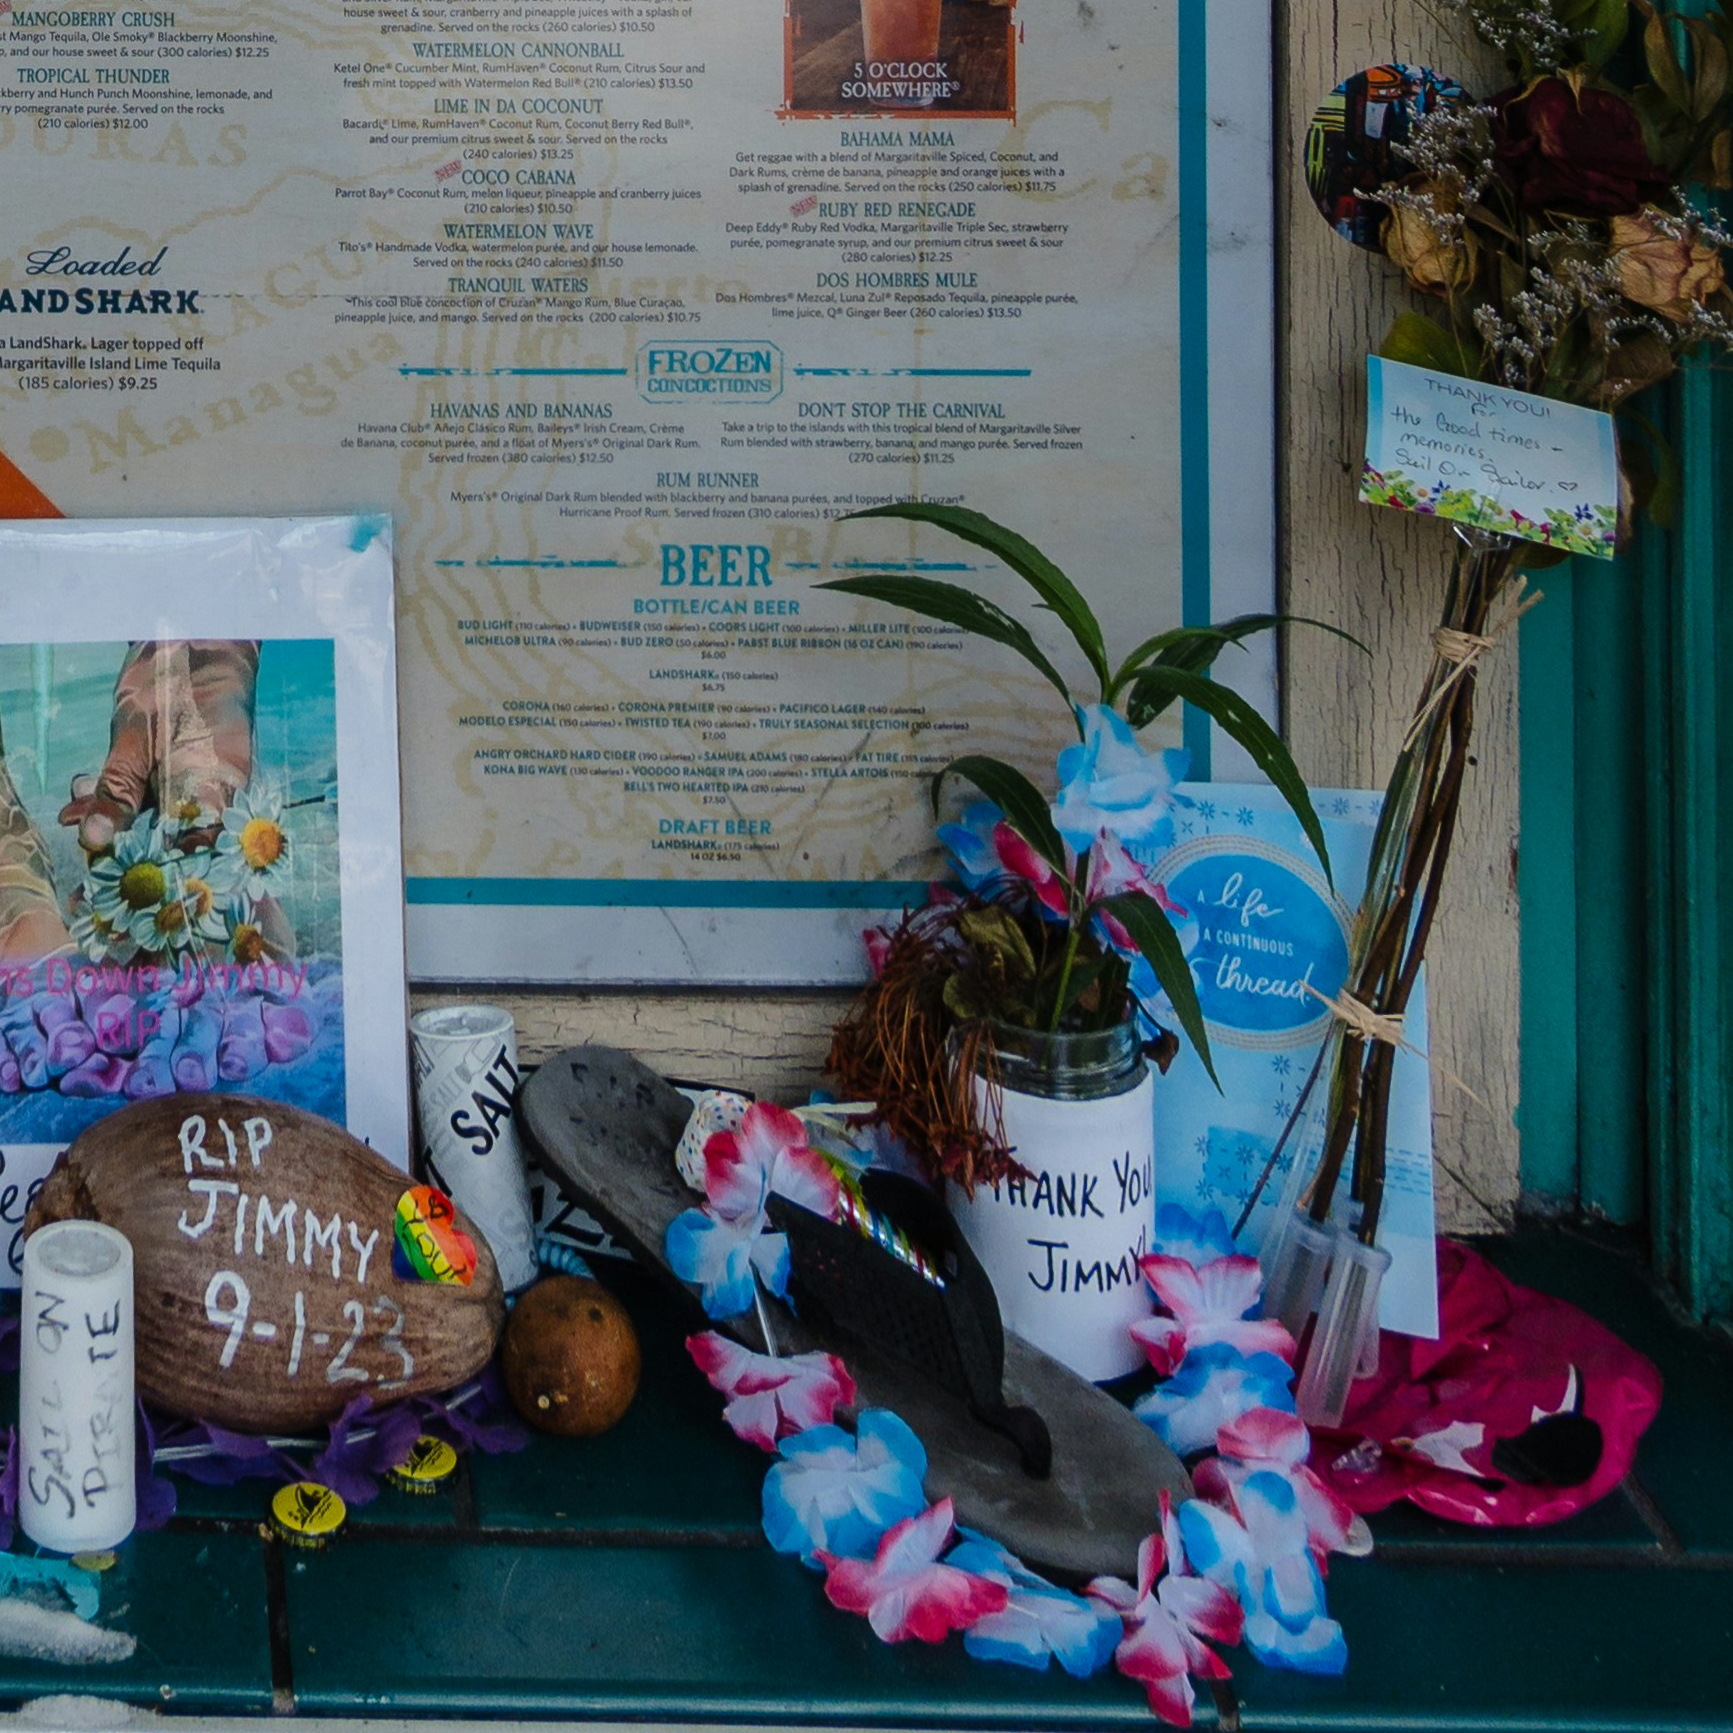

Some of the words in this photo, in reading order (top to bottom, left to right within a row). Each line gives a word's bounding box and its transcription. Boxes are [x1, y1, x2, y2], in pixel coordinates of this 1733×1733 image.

[854, 63, 862, 78] 5
[866, 59, 947, 78] O'CLOCK
[841, 131, 903, 147] BAHAMA
[909, 132, 955, 146] MAMA
[26, 246, 161, 276] Loaded
[91, 337, 131, 352] Lager
[132, 335, 181, 353] topped
[185, 337, 204, 350] off
[649, 348, 771, 375] FROZEN
[19, 376, 49, 391] (185
[53, 376, 114, 390] calories)
[118, 376, 157, 391] $9.25
[90, 357, 131, 370] Island
[135, 357, 167, 370] Lime
[171, 357, 220, 372] Tequila
[647, 378, 771, 393] CONCOCTIONS
[1424, 378, 1497, 408] THANK
[1501, 395, 1551, 420] YOU!
[1391, 406, 1421, 428] the
[1489, 423, 1541, 452] times
[1394, 448, 1431, 475] Sail
[661, 544, 771, 586] BEER
[633, 598, 747, 614] BOTTLE/CAN
[754, 600, 799, 615] BEER
[659, 819, 719, 834] DRAFT
[725, 816, 771, 837] BEER
[1196, 889, 1207, 904] A
[1214, 872, 1285, 929] life
[1203, 928, 1212, 942] A
[1216, 930, 1294, 957] CONTINUOUS
[45, 960, 160, 995] Down
[172, 955, 307, 1002] Jimmy
[96, 1011, 160, 1048] RIP
[451, 1044, 519, 1156] SALT
[177, 1115, 275, 1175] RIP
[1112, 1150, 1153, 1215] YOU
[176, 1179, 380, 1284] JIMMY
[33, 1290, 71, 1355] ON
[203, 1270, 415, 1390] 9-1-23
[80, 1298, 124, 1509] PIRATE
[26, 1379, 77, 1520] SAIL
